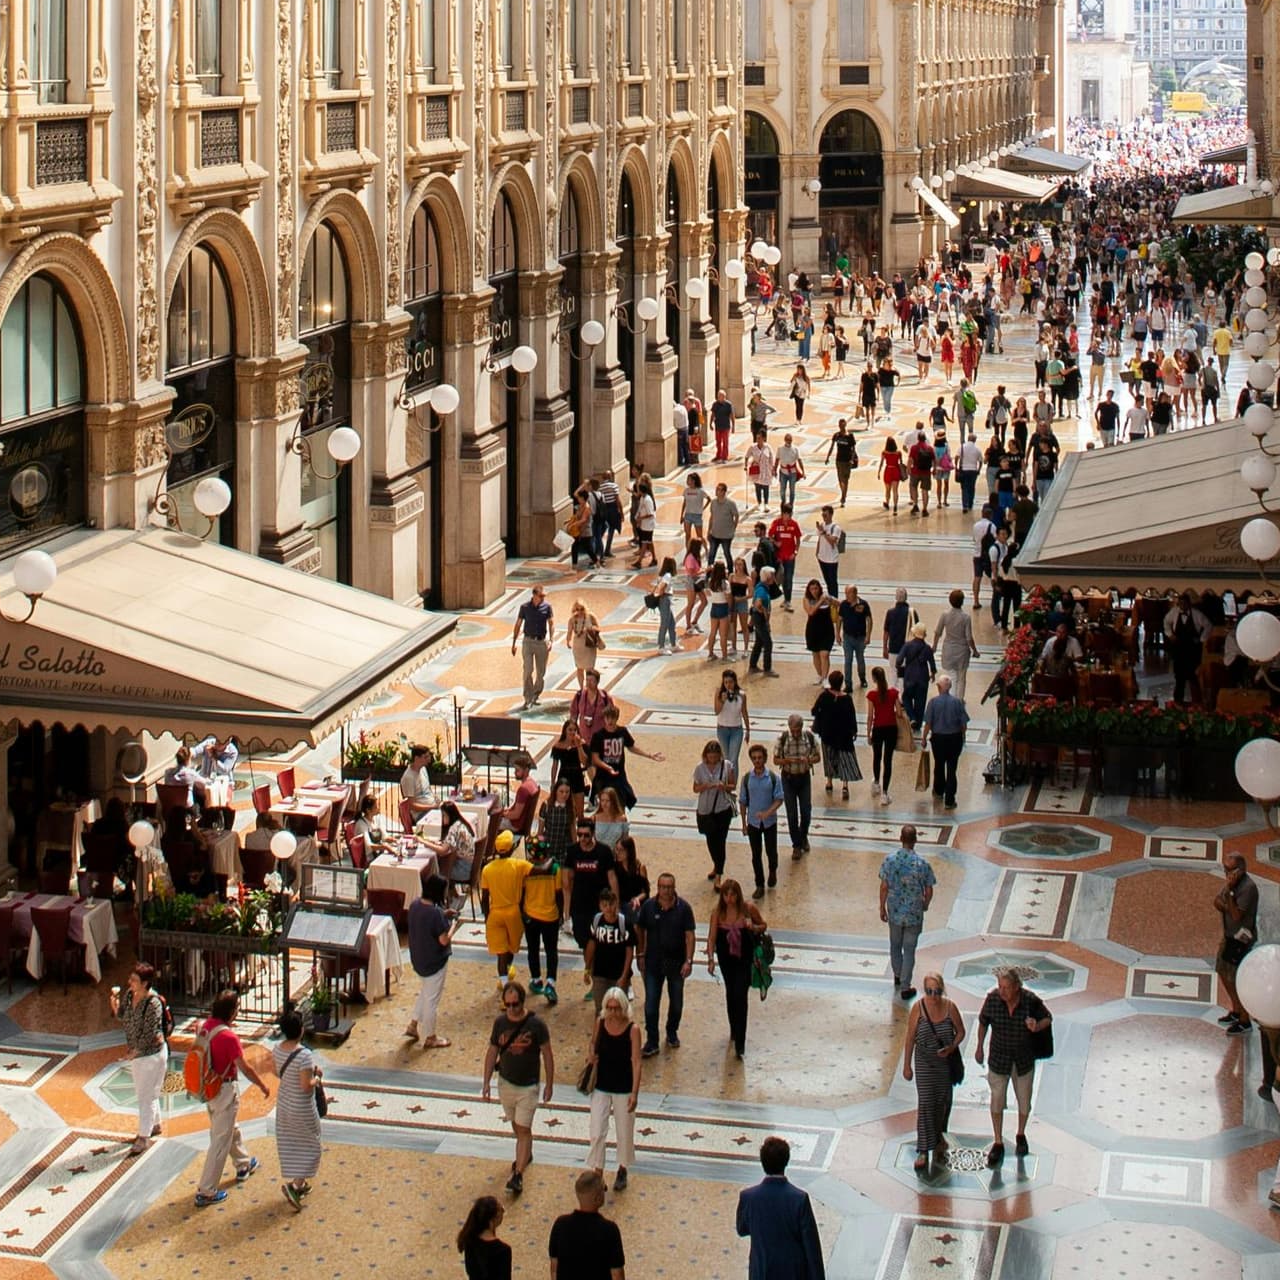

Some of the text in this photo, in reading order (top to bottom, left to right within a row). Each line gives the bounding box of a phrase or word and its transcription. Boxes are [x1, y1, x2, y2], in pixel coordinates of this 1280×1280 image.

[18, 645, 106, 676] Salotto
[71, 681, 104, 694] PIZZA
[162, 688, 194, 701] WINE
[603, 737, 624, 756] 501
